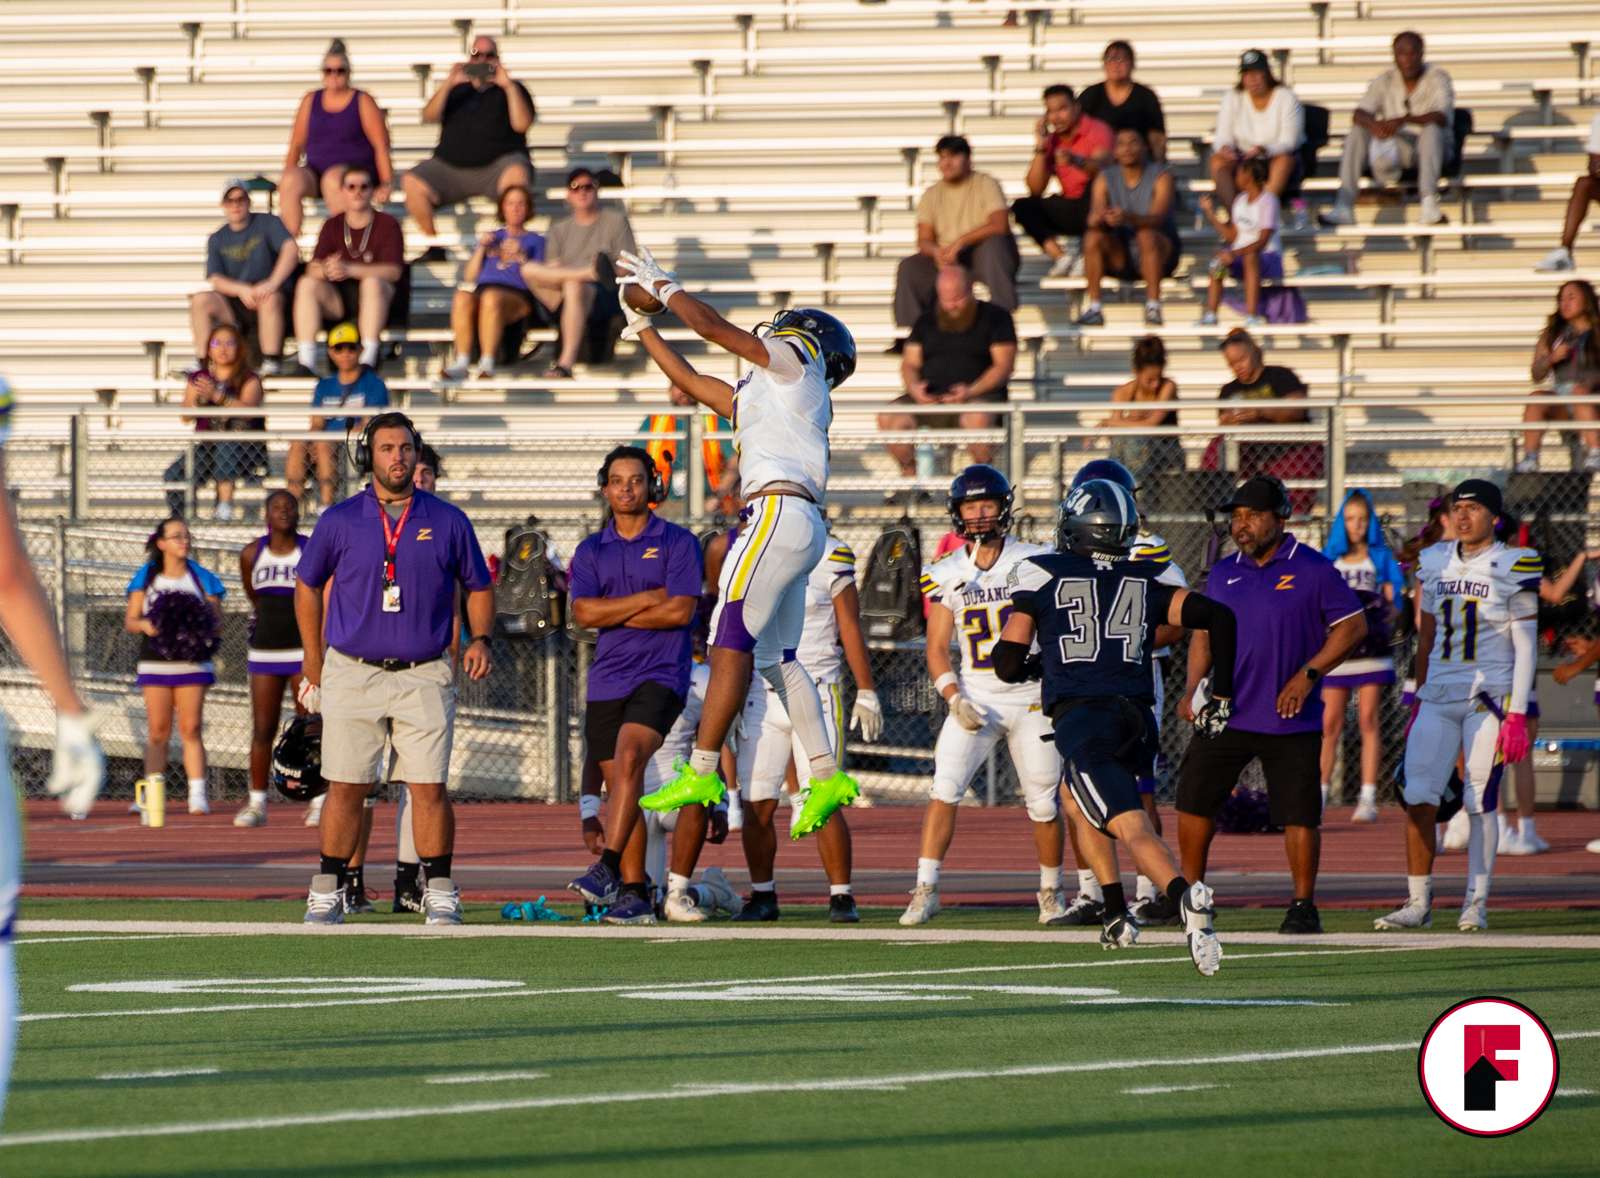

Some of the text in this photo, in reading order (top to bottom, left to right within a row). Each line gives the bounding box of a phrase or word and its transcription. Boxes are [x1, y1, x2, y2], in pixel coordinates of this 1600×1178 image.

[1066, 487, 1092, 516] 34
[416, 527, 433, 541] Z
[641, 547, 660, 560] Z
[1274, 574, 1296, 590] Z
[1436, 580, 1490, 598] DURANGO
[962, 586, 1011, 606] DURANG
[1055, 577, 1148, 665] 34
[1439, 597, 1479, 662] 11
